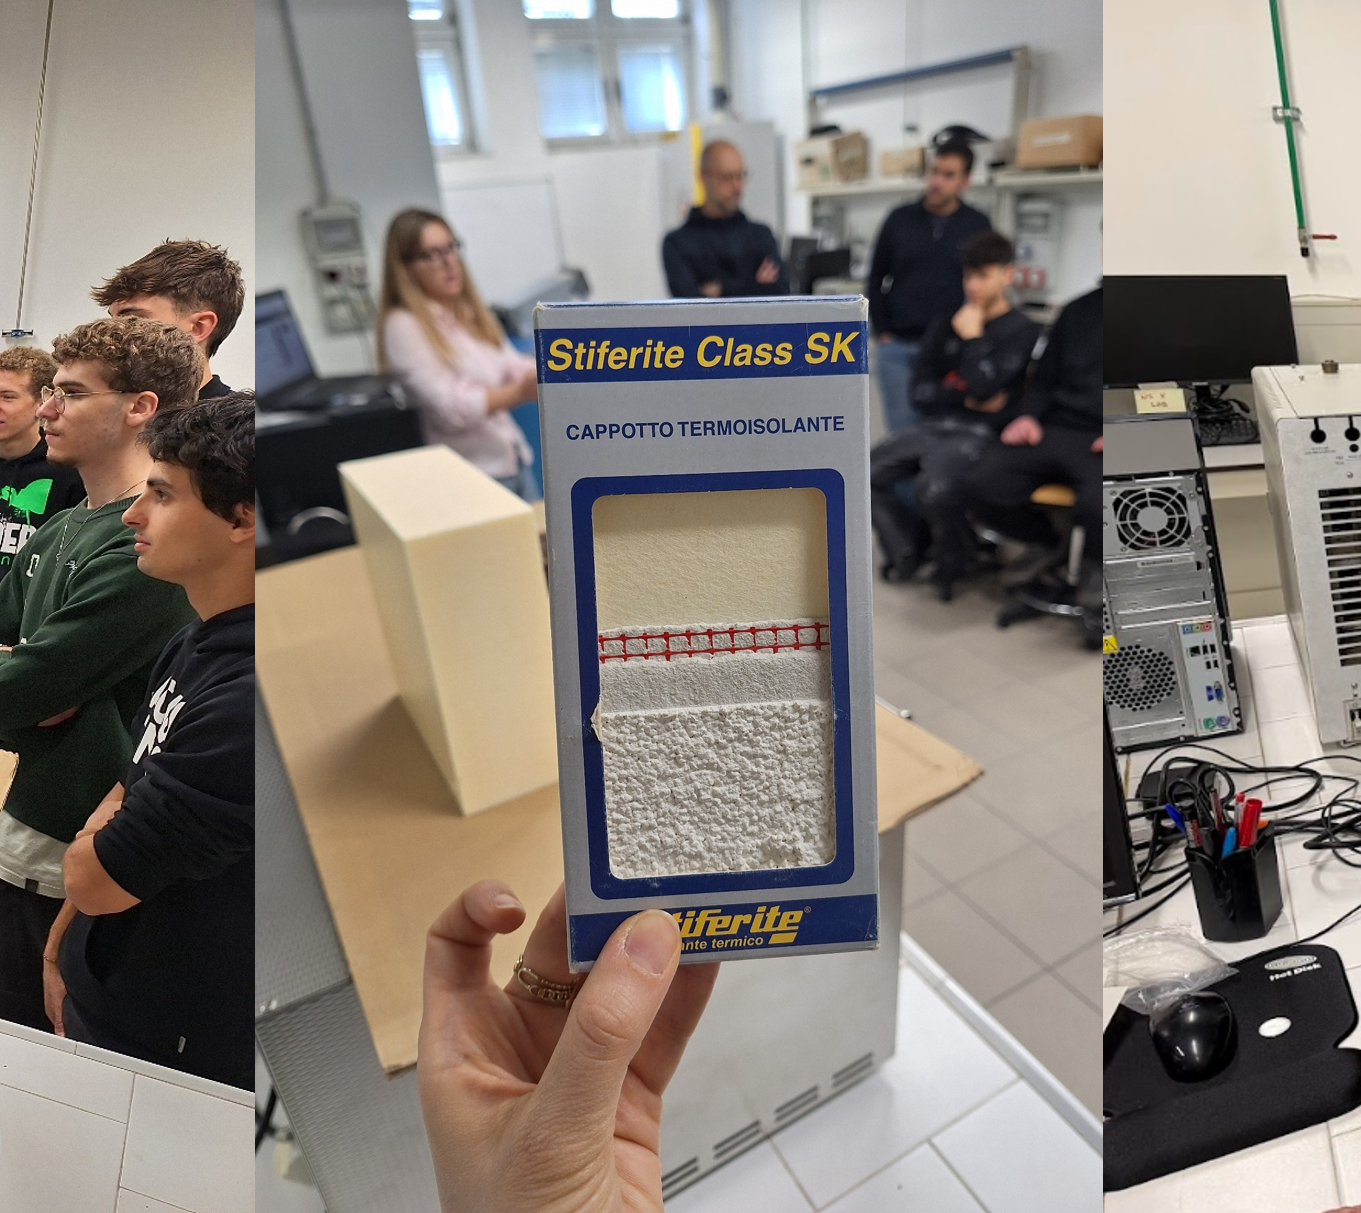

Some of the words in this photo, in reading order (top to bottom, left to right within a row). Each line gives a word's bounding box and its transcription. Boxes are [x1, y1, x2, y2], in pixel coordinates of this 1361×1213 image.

[547, 338, 685, 371] Stiferite
[696, 335, 793, 368] Class
[804, 331, 860, 365] SK
[565, 422, 674, 441] CAPPOTTO
[677, 415, 846, 438] TERMOISOLANTE
[672, 905, 804, 938] tiferite
[680, 939, 708, 951] ante
[711, 935, 765, 950] termico
[1269, 969, 1293, 981] Hot
[1293, 963, 1322, 975] Disk
